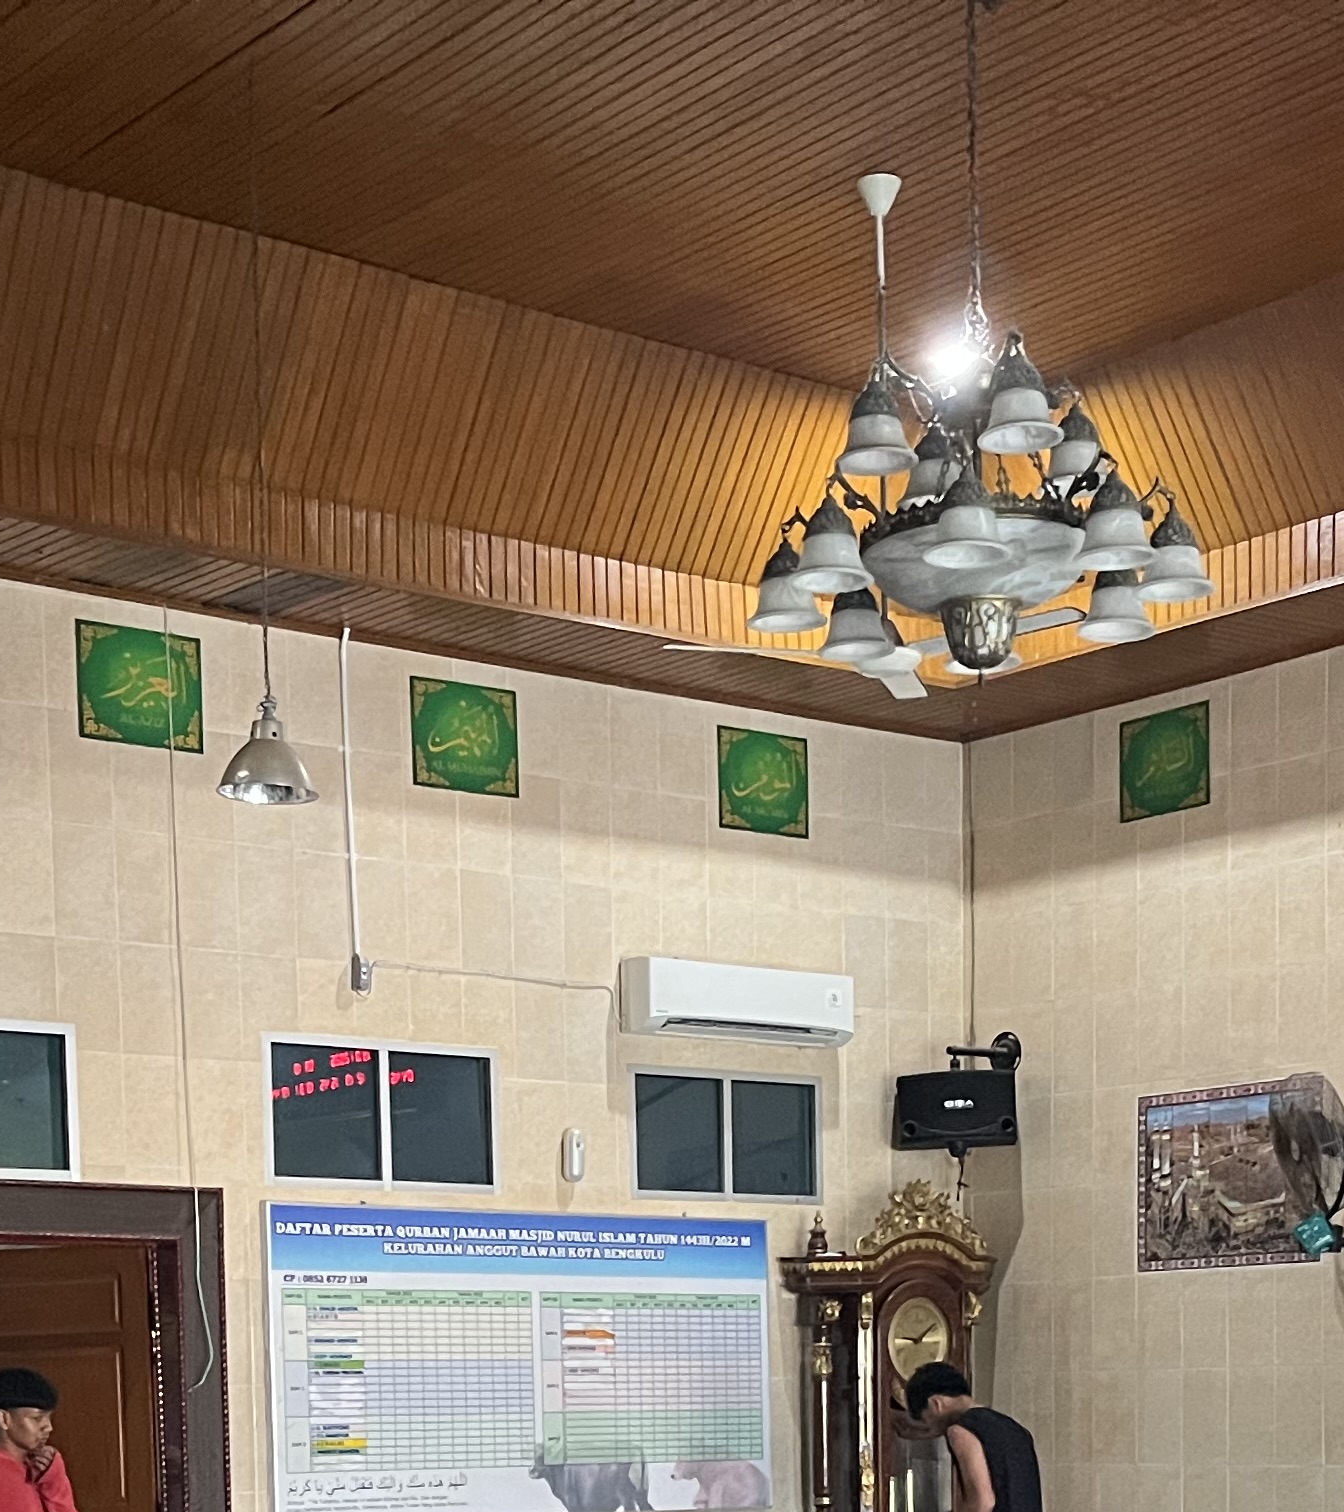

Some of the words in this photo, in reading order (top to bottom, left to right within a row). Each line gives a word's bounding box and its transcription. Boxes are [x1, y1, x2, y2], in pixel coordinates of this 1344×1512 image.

[275, 1222, 332, 1236] DAFTAR
[334, 1224, 395, 1238] PESERTA
[396, 1225, 451, 1240] QURBAN
[453, 1227, 507, 1241] JAMAAH
[509, 1229, 555, 1244] MASJID
[557, 1231, 596, 1243] NURUL
[598, 1231, 637, 1244] ISLAM
[638, 1233, 679, 1245] TAHUN
[740, 1236, 751, 1247] M
[383, 1242, 463, 1255] KELURAHAN
[466, 1243, 519, 1256] ANGGUT
[521, 1245, 566, 1257] BAWAH
[568, 1246, 602, 1258] KOTA
[604, 1248, 665, 1260] BENGKULU
